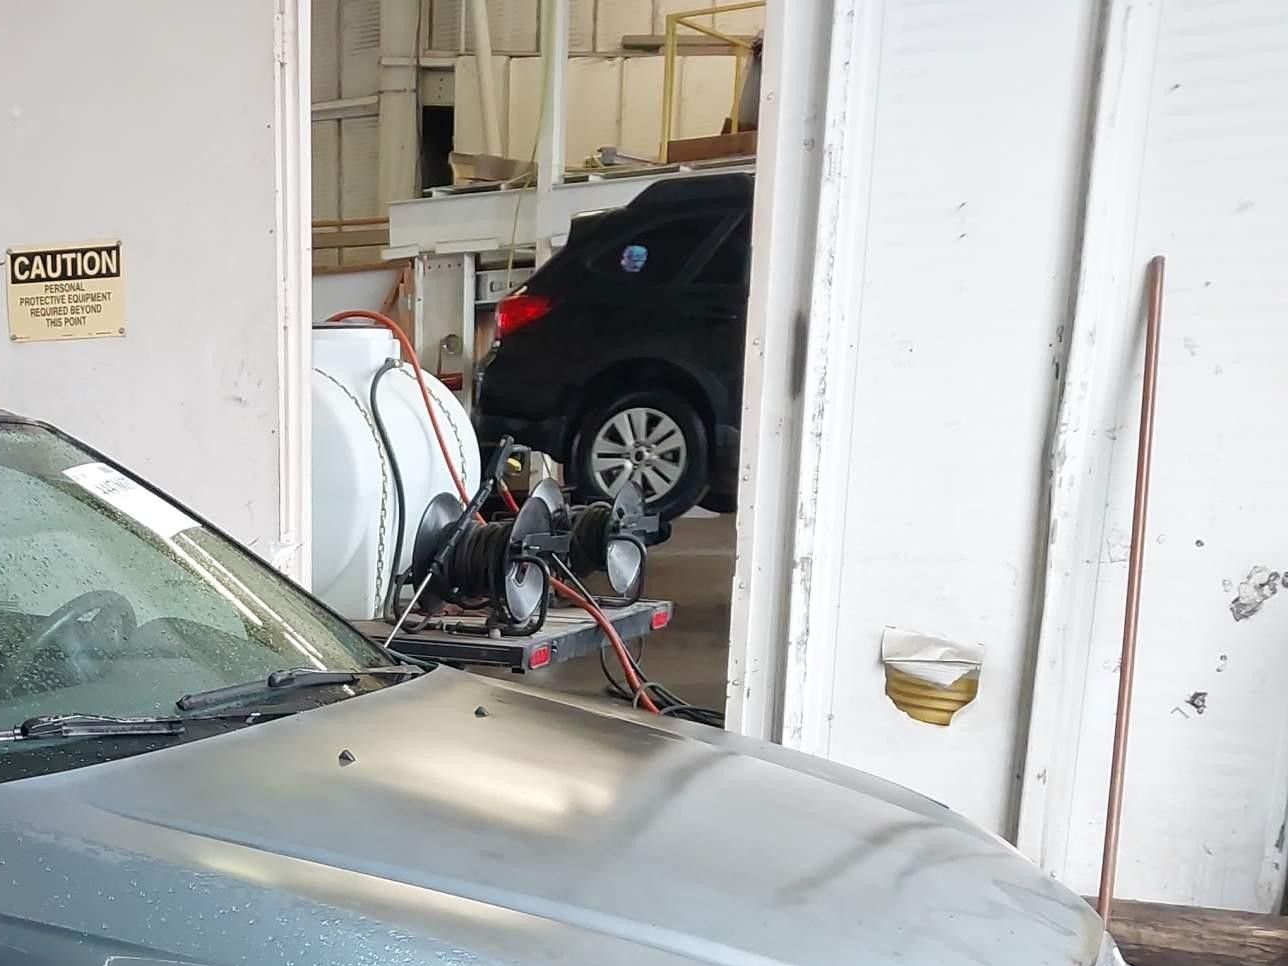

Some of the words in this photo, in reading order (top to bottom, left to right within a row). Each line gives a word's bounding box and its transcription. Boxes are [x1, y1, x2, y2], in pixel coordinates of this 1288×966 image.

[14, 250, 117, 280] CAUTION
[44, 282, 85, 294] PERSONAL
[19, 294, 66, 306] PROTECTIVE
[67, 291, 112, 304] EQUIPMENT
[30, 305, 68, 317] REQUIRED
[70, 303, 102, 315] BEYOND
[46, 317, 62, 327] THIS
[64, 316, 86, 327] POINT
